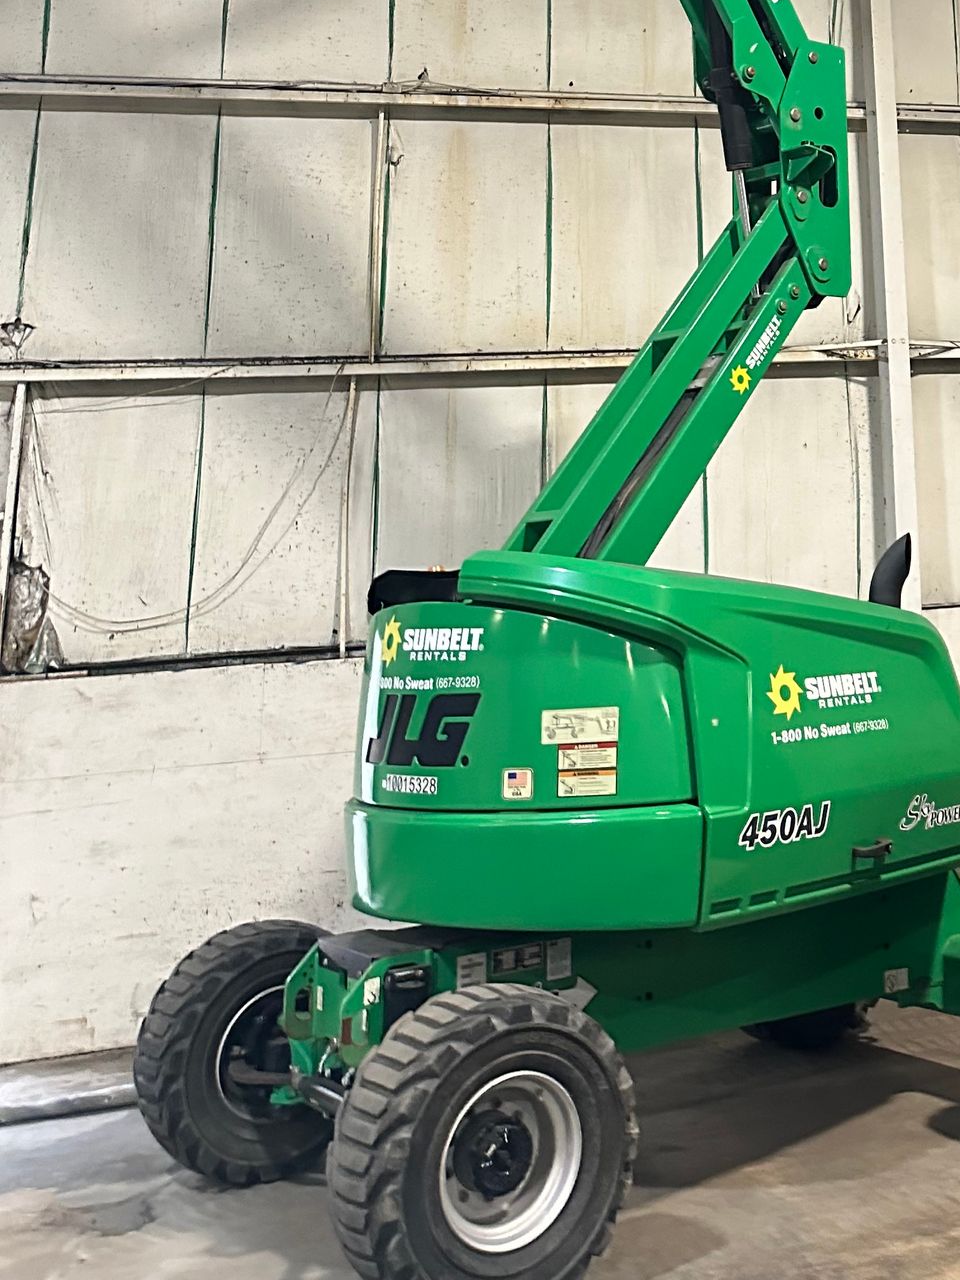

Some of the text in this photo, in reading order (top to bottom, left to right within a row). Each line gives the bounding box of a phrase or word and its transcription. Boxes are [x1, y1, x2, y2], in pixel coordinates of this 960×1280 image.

[745, 314, 781, 370] SUNBELT
[756, 330, 780, 367] RENTALS
[402, 627, 484, 651] SUNBELT
[409, 651, 467, 661] RENTALS
[393, 676, 404, 690] No
[405, 676, 434, 690] Sweat
[435, 675, 480, 689] (667-9328)
[804, 671, 879, 700] SUNBELT
[818, 694, 873, 709] RENTALS
[771, 727, 802, 745] 1-800
[803, 725, 819, 740] No
[820, 722, 851, 738] Sweat
[738, 800, 831, 851] 450AJ
